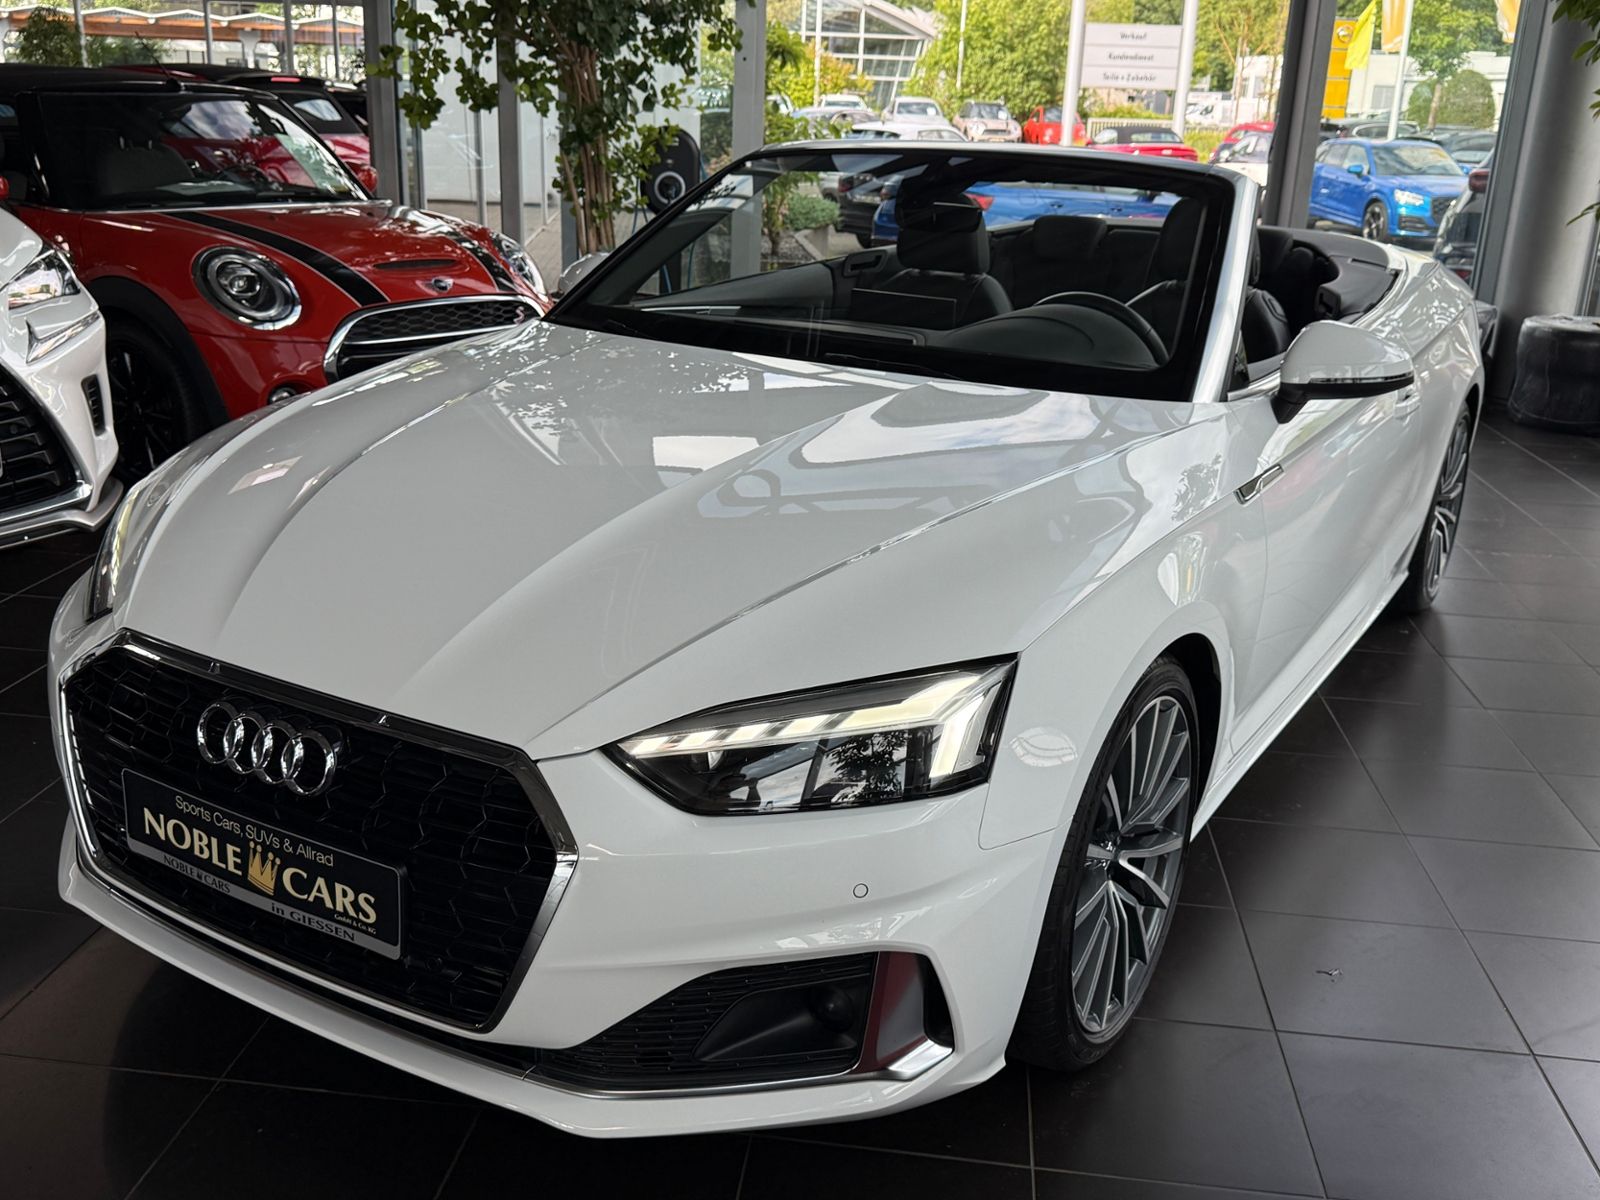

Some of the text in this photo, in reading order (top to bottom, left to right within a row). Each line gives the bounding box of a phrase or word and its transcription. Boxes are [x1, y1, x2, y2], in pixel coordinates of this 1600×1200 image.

[1120, 32, 1147, 40] Verkauf
[175, 795, 334, 867] Sports Cars, SUVs & Allrad
[143, 807, 377, 924] NOBLE CARS
[163, 855, 231, 894] NOBLE CARS
[271, 902, 355, 941] in GIESSEN
